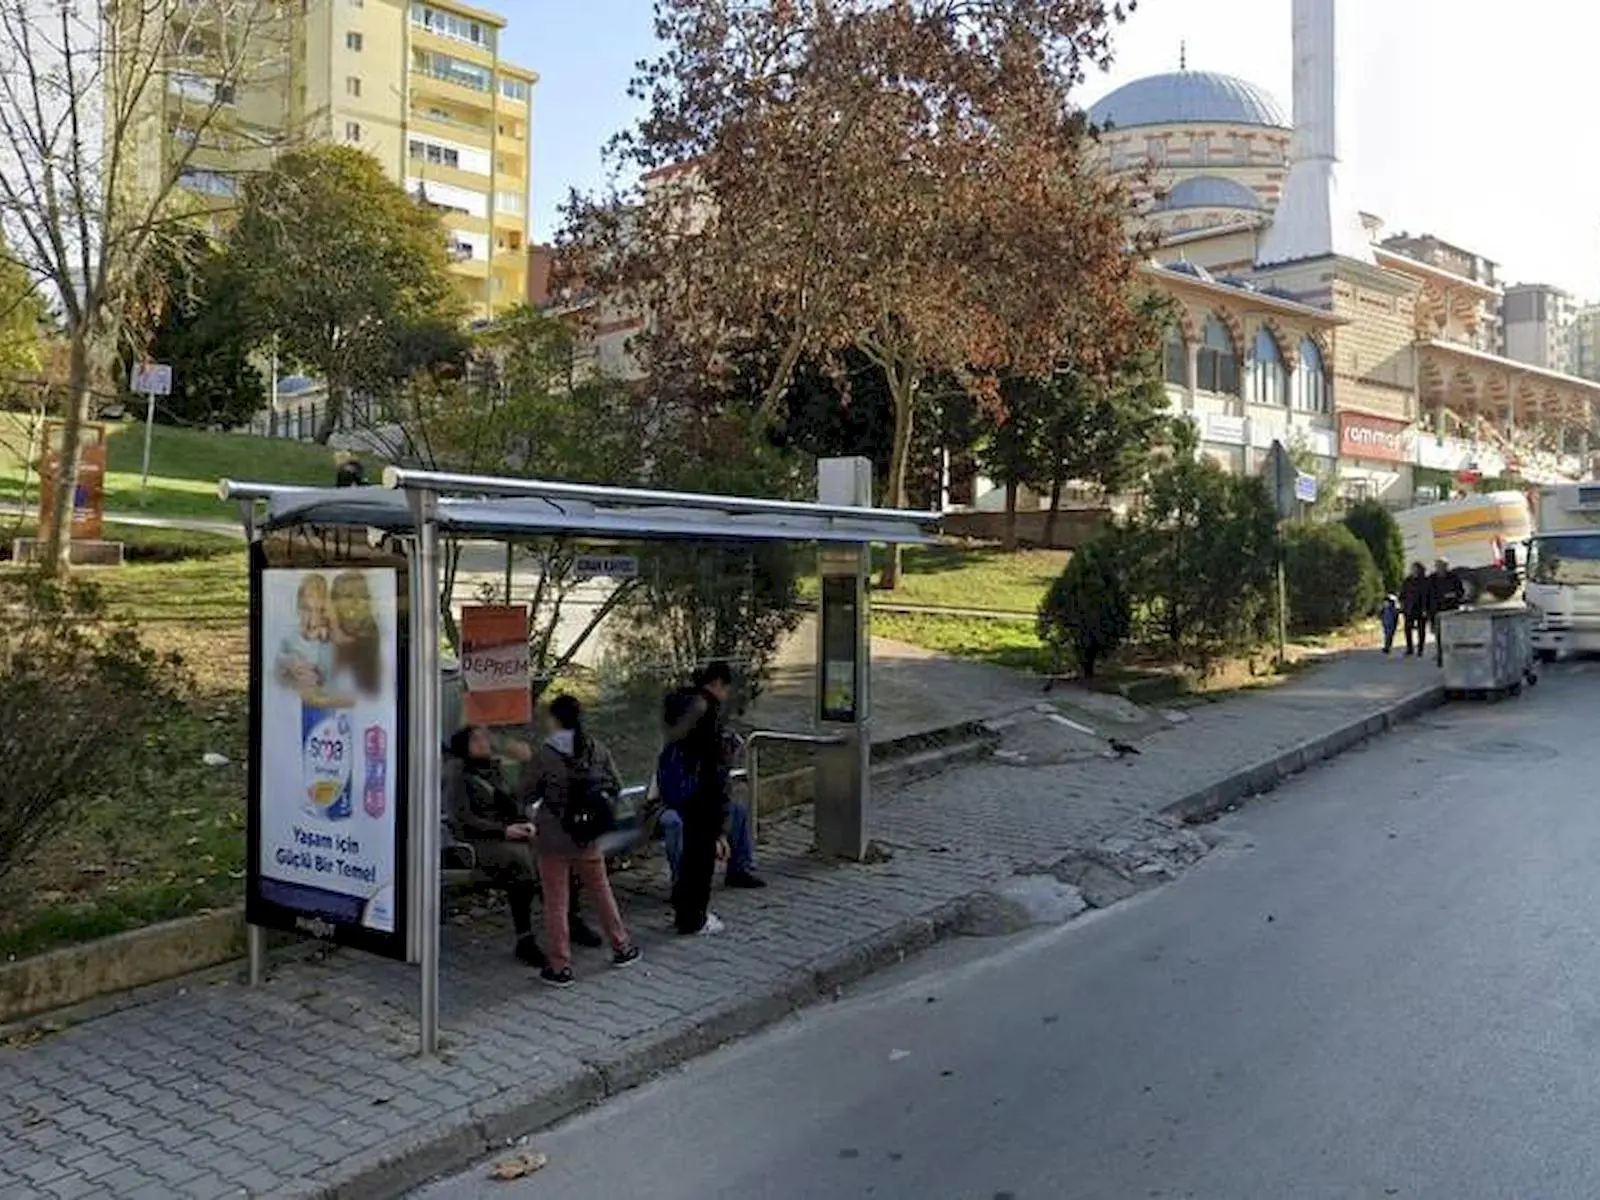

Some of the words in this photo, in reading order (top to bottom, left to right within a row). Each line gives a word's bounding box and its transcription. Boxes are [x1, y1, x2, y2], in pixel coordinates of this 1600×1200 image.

[310, 737, 343, 760] sma
[292, 826, 332, 849] Yaşam
[276, 846, 311, 869] Güçlü
[315, 855, 333, 873] Bir
[336, 859, 376, 882] Temel
